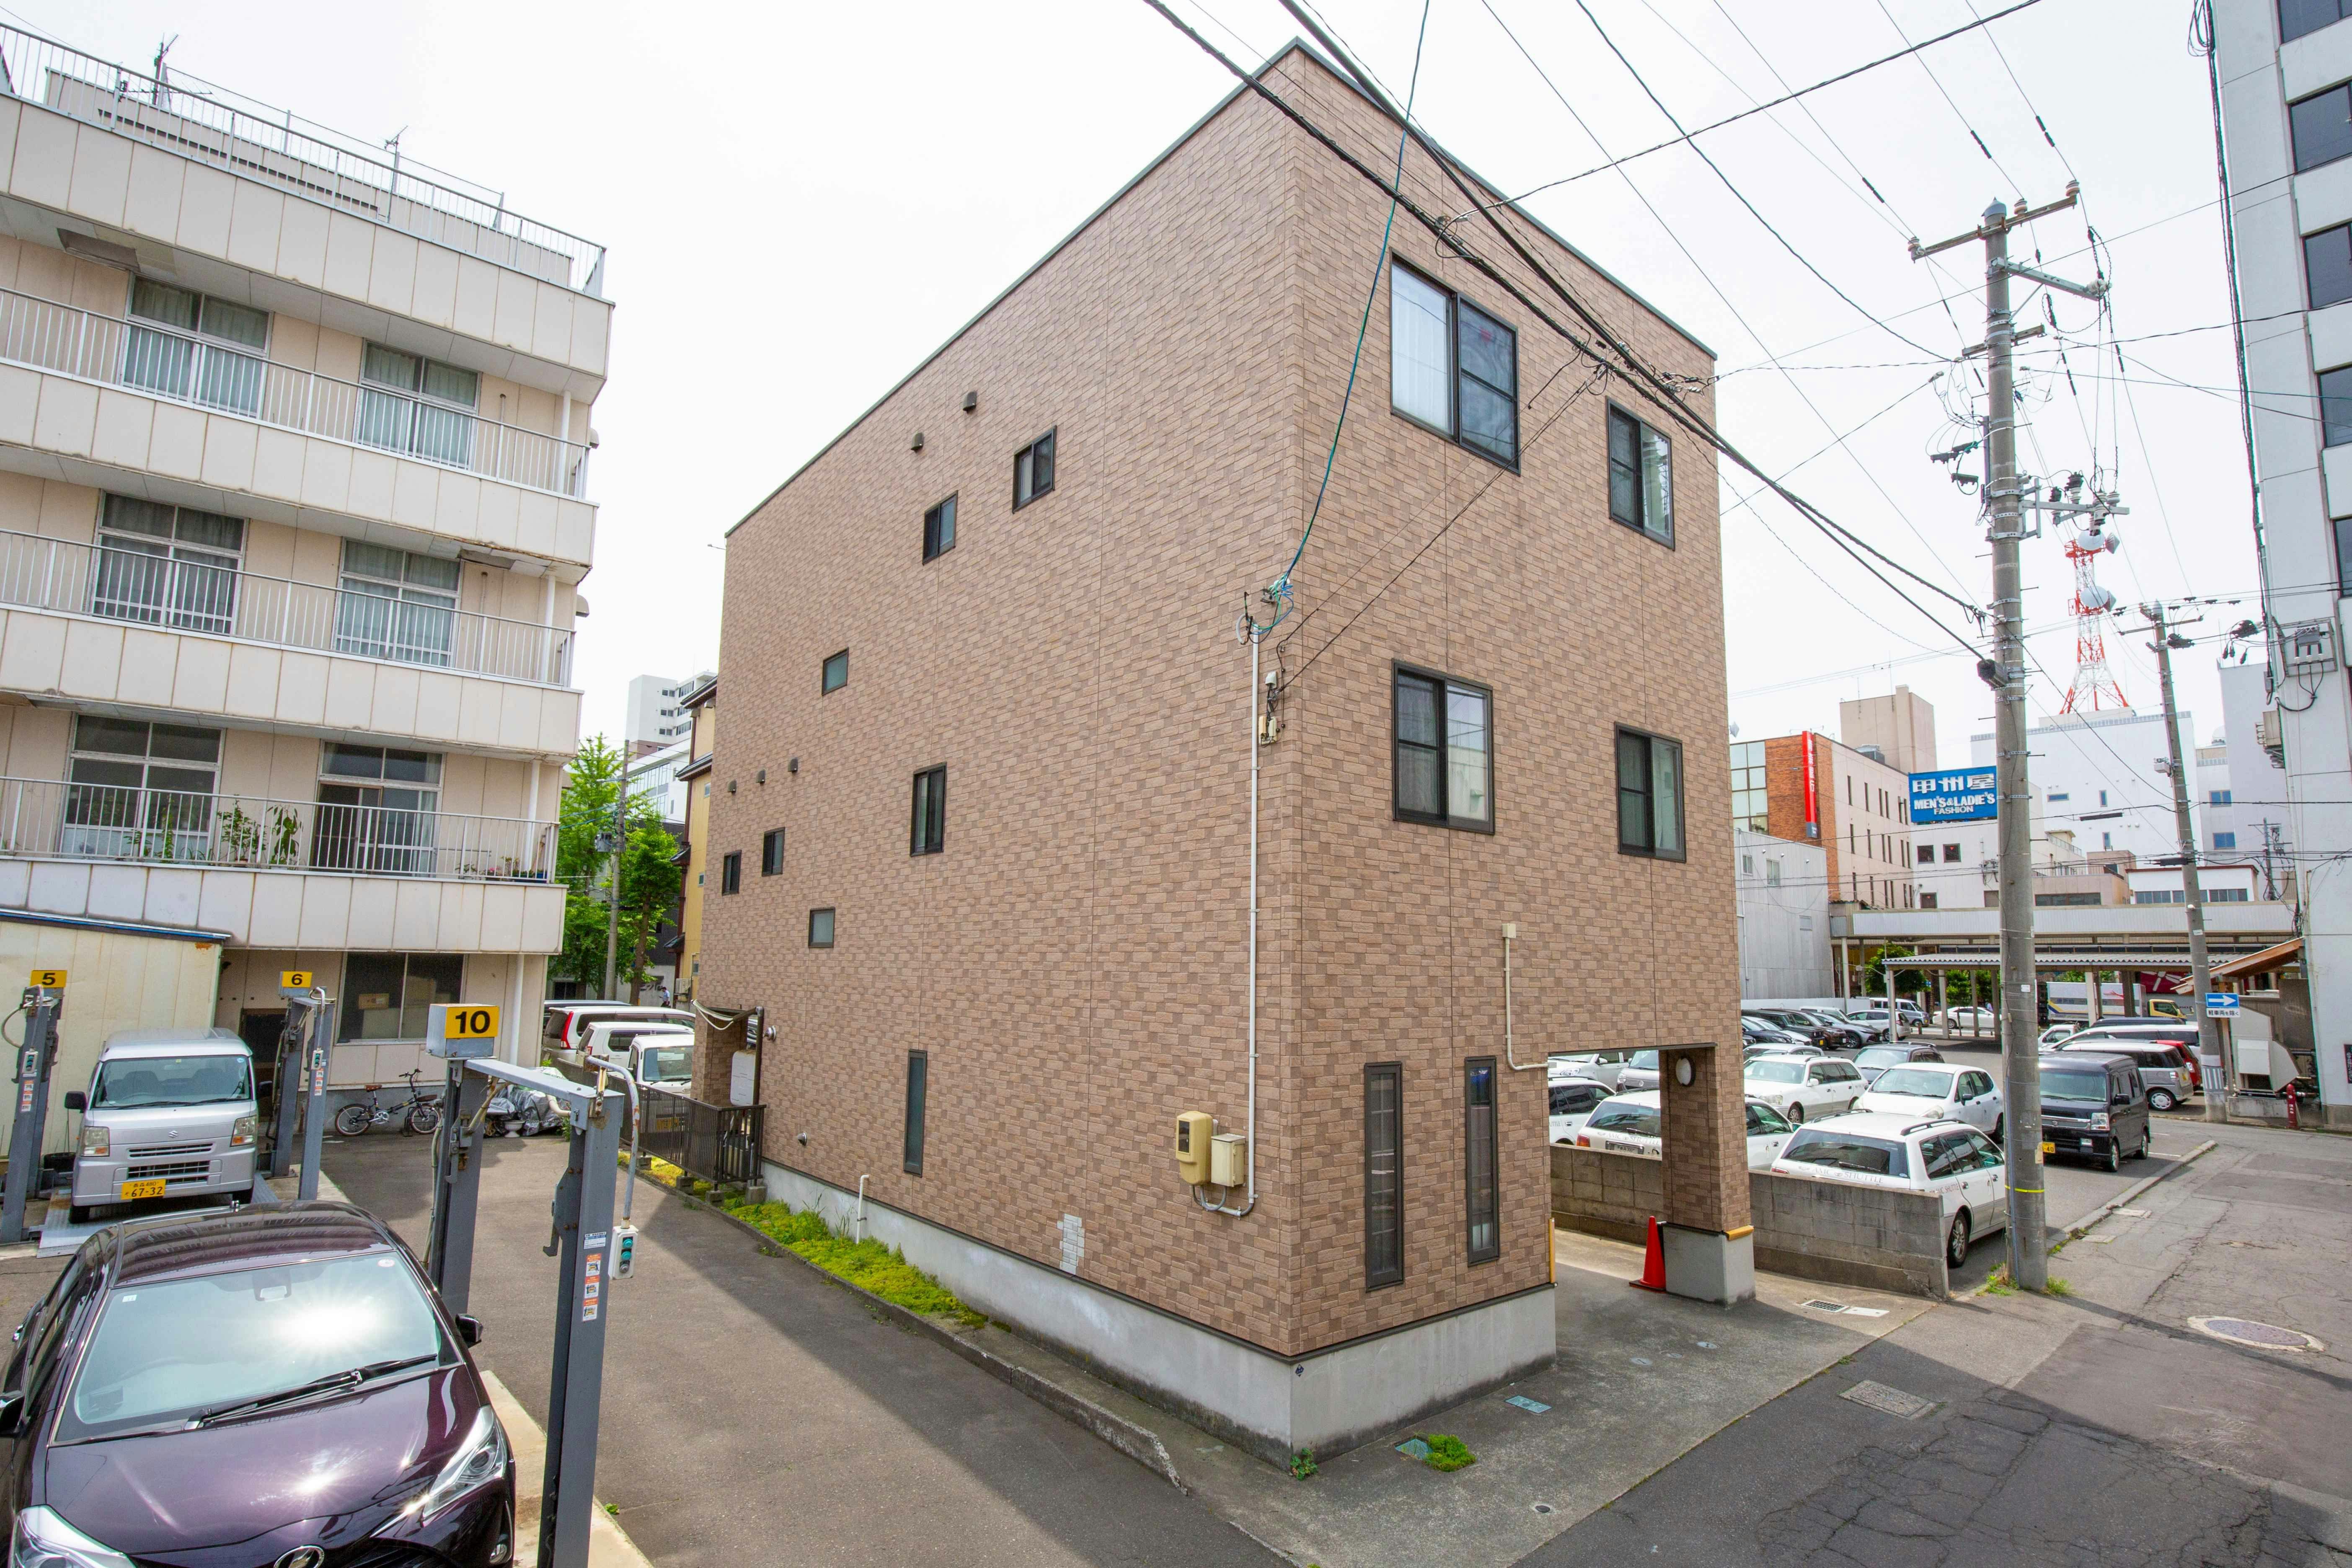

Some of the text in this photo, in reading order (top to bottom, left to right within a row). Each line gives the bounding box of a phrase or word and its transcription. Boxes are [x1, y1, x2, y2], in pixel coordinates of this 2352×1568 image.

[1913, 773, 1995, 793] 甲州屋
[1934, 806, 1974, 815] FASHION
[42, 972, 55, 985] 5
[292, 974, 302, 985] 6
[455, 1010, 490, 1034] 10
[1812, 1166, 1884, 1183] AMC SHUTTLE
[132, 1186, 163, 1197] 67-32
